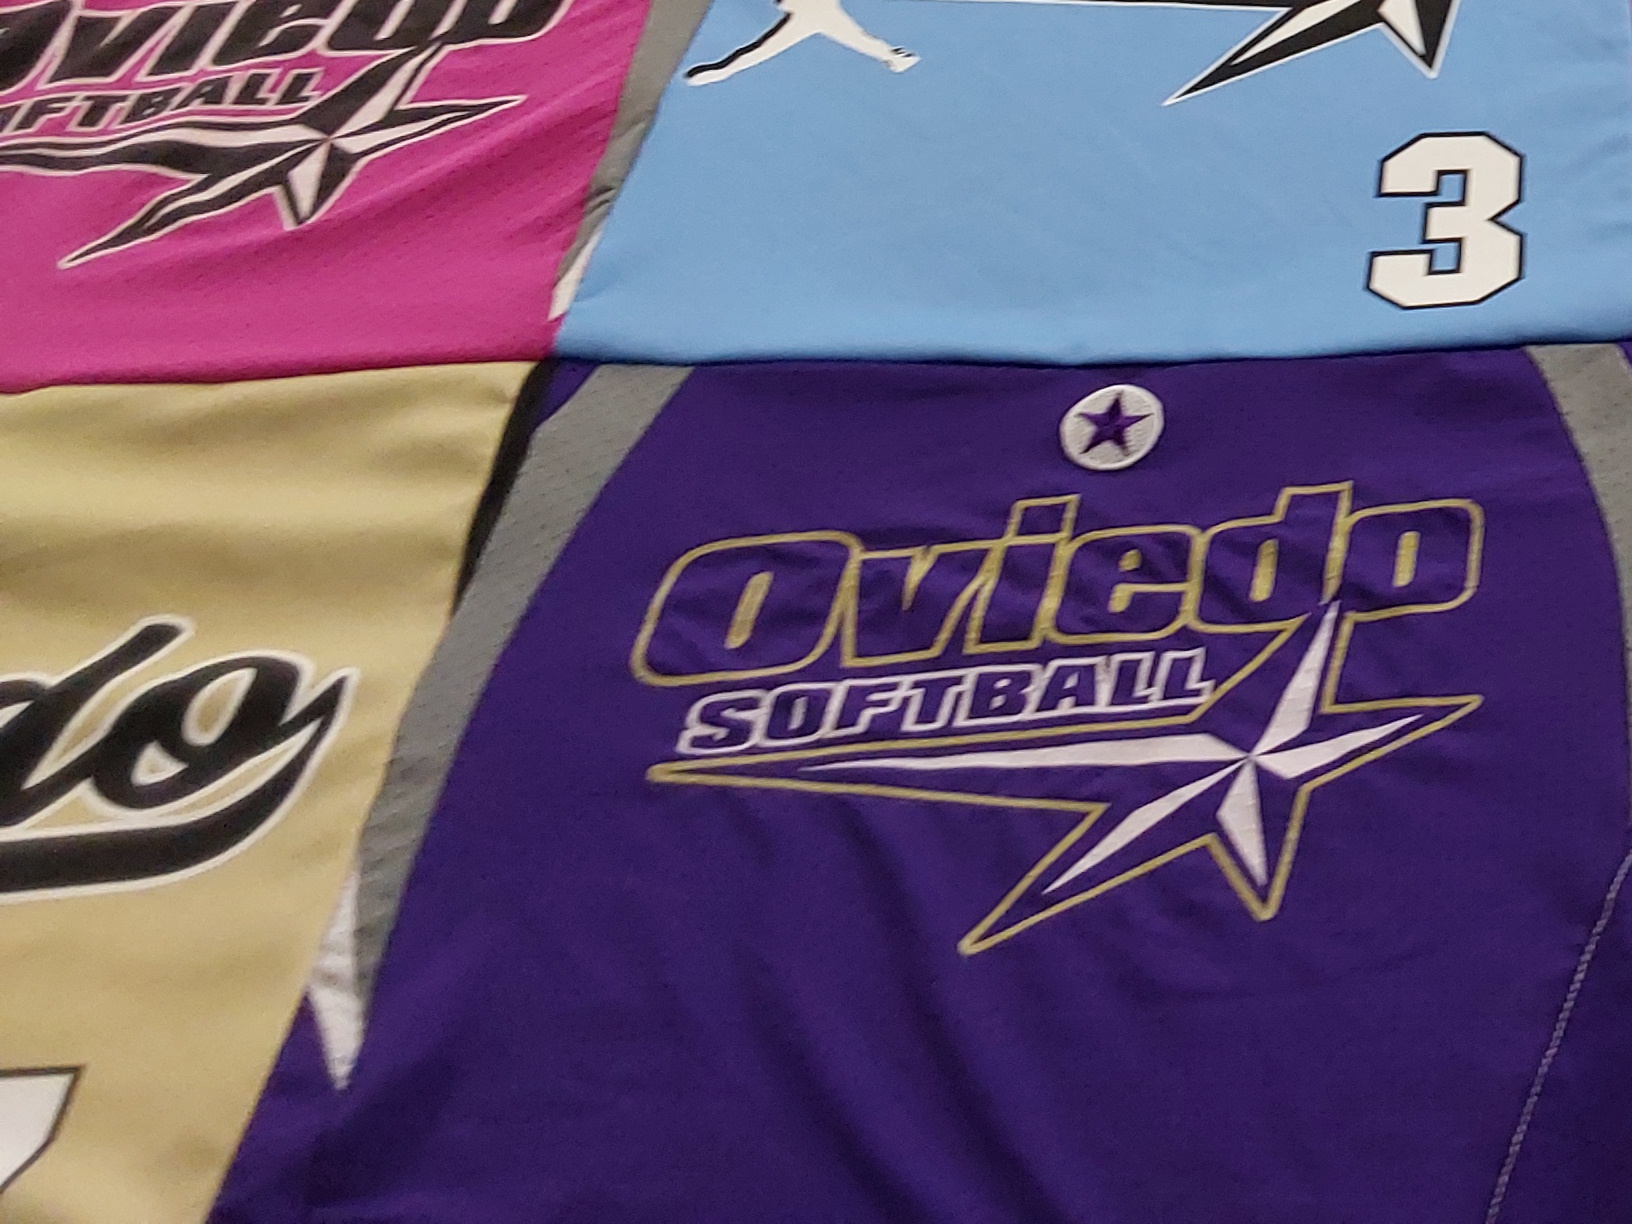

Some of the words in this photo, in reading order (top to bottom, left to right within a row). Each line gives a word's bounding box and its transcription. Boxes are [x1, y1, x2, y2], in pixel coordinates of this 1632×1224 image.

[0, 66, 332, 136] FTBALL
[1366, 131, 1525, 311] 3
[630, 479, 1484, 687] Oviedo
[675, 647, 1218, 755] SOFTBALL
